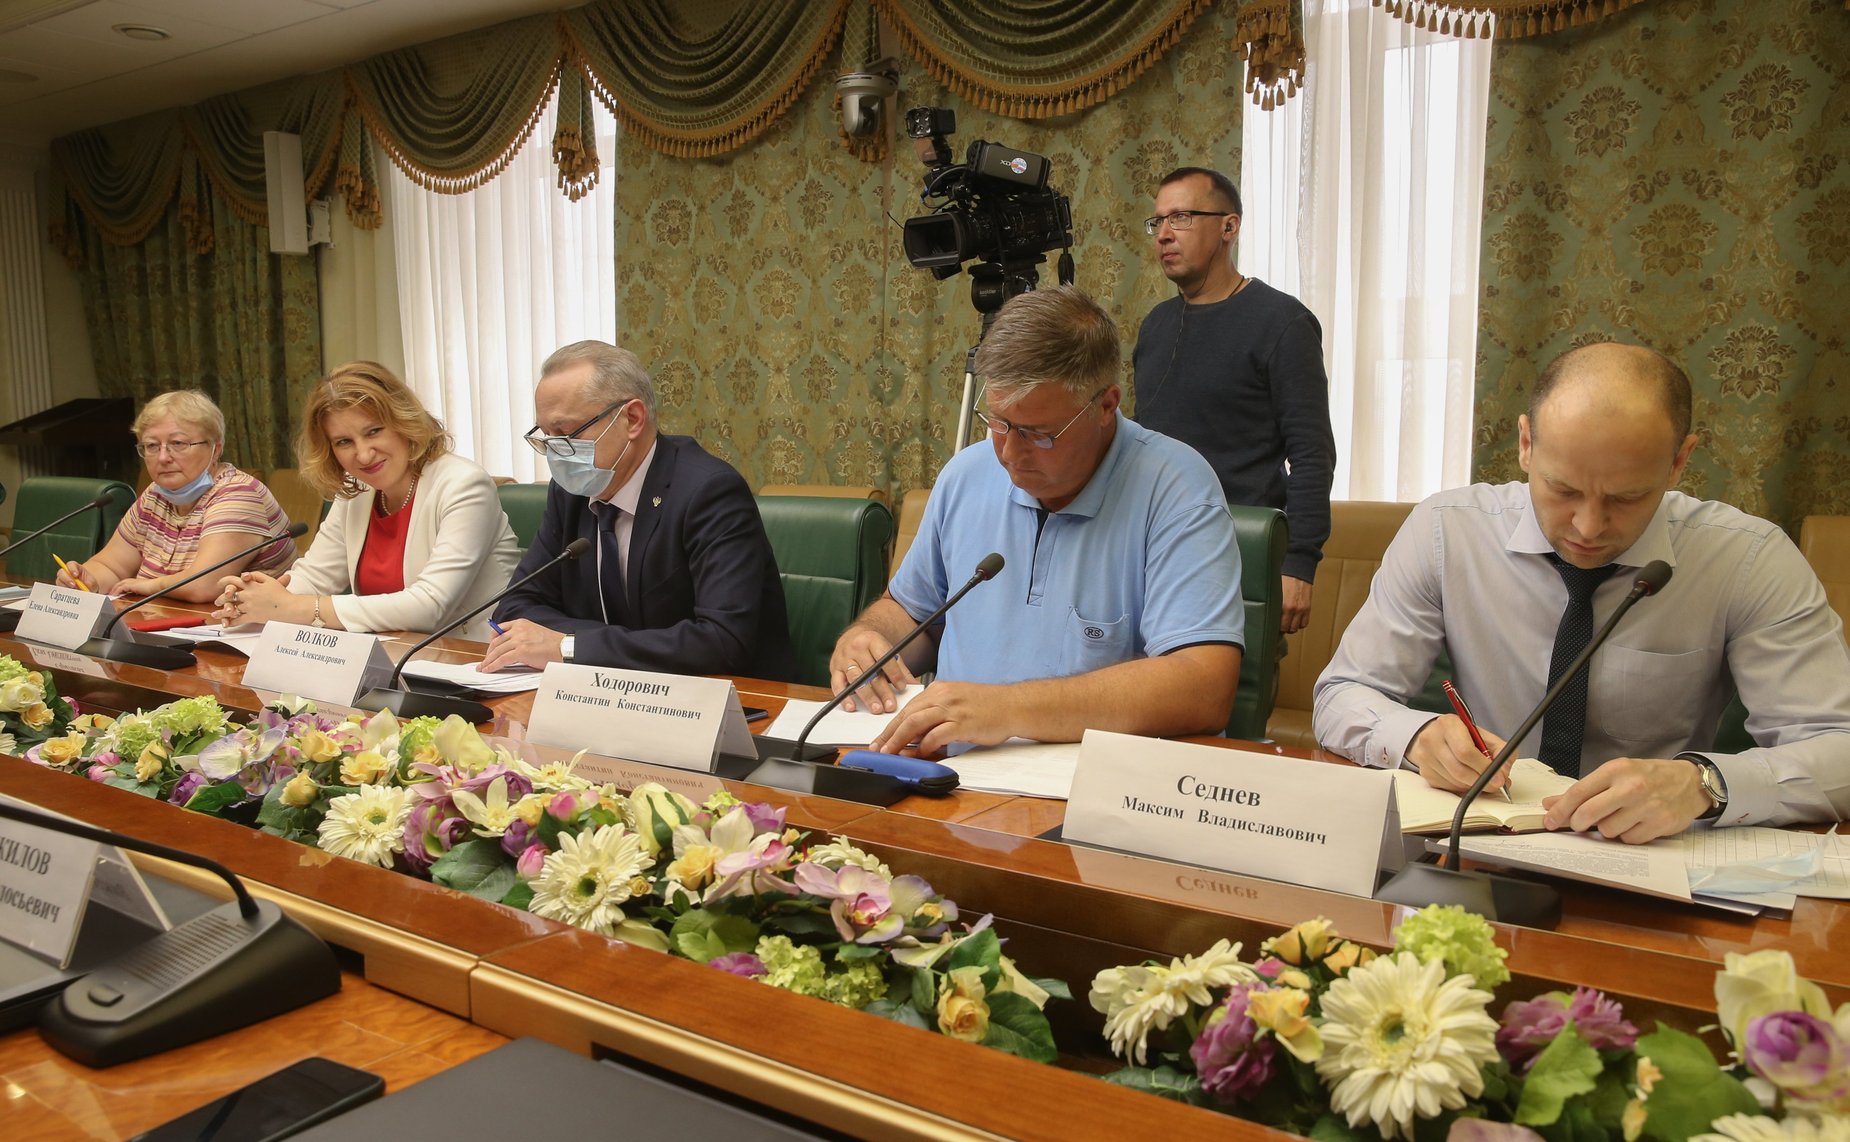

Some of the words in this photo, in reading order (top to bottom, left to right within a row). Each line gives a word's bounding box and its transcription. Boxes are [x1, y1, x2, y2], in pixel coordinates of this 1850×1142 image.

[29, 600, 44, 612] Елена
[43, 604, 80, 620] Александровна
[295, 629, 339, 648] ВОЛКОВ
[1088, 629, 1100, 637] RS
[274, 645, 299, 657] Алексей
[300, 649, 346, 666] Александрович
[590, 672, 671, 696] Ходорович
[555, 690, 611, 708] Константин
[616, 698, 702, 721] Константинович
[1176, 774, 1261, 808] Седнев
[1121, 795, 1185, 820] Максим
[1197, 809, 1327, 846] Владиславович
